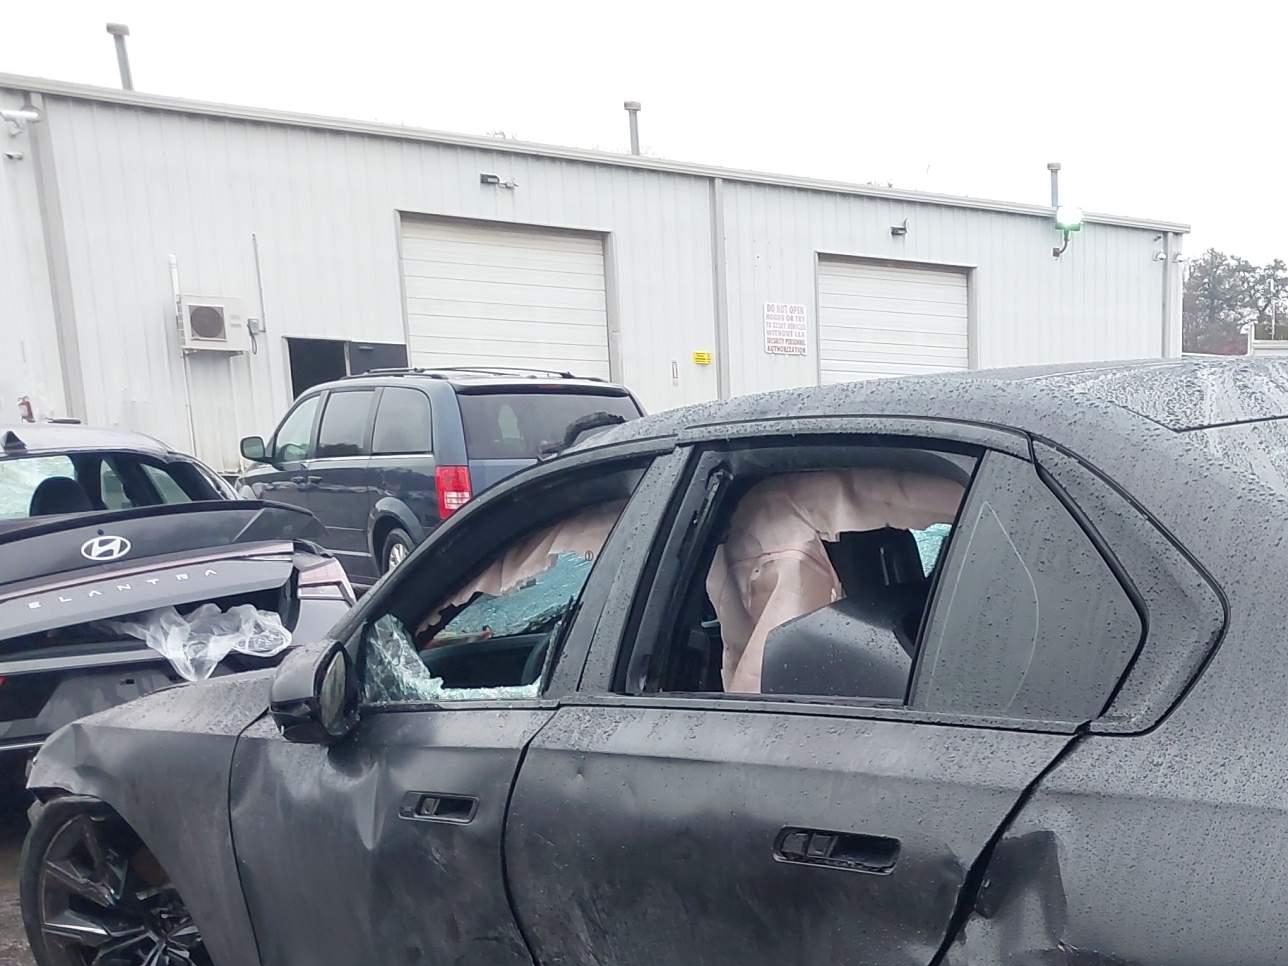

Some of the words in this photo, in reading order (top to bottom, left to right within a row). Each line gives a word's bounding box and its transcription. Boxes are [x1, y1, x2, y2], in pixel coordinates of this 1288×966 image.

[766, 304, 775, 313] DO
[776, 304, 788, 314] NOT
[789, 305, 804, 314] OPEN
[767, 345, 806, 353] AUTHORIZATION
[28, 568, 217, 609] ELANTRA
